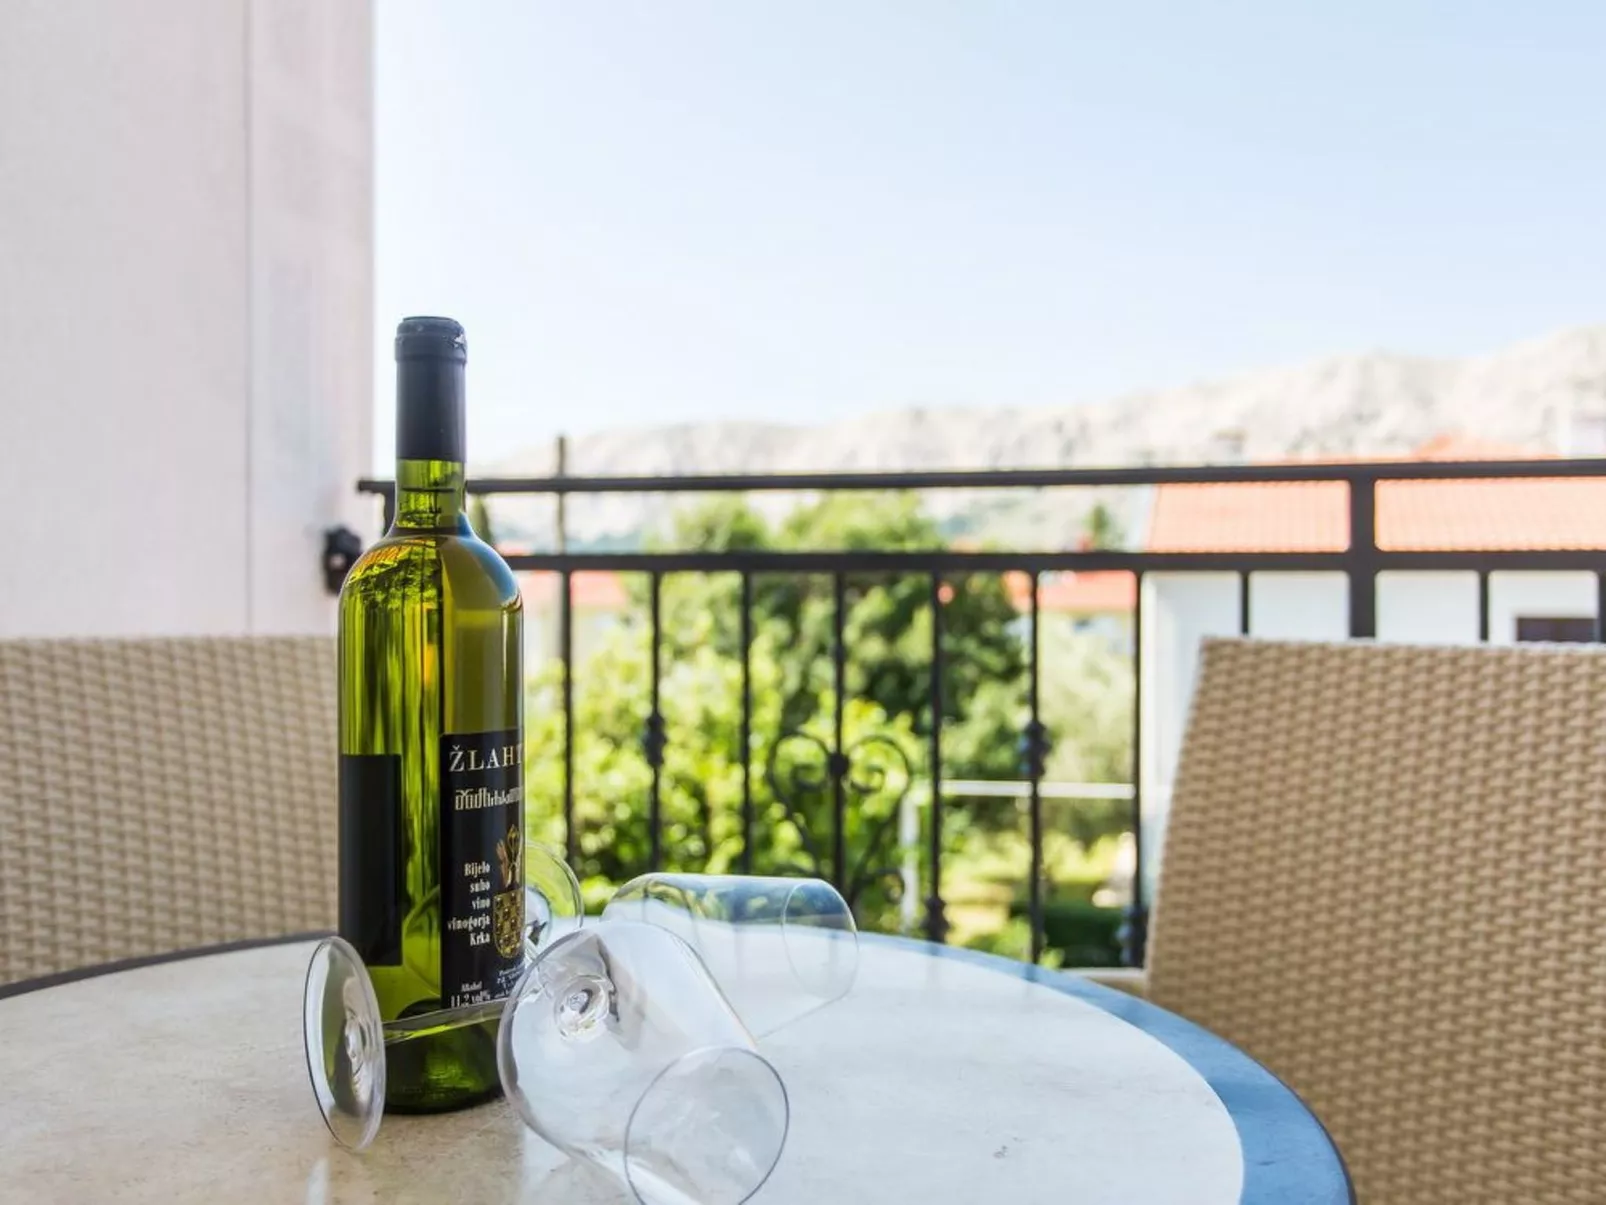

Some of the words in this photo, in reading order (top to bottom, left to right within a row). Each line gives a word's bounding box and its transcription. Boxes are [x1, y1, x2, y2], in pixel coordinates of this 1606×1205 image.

[464, 861, 490, 878] Bijelo
[472, 897, 490, 910] vino
[447, 913, 490, 931] vinogorja
[470, 932, 490, 946] Krka
